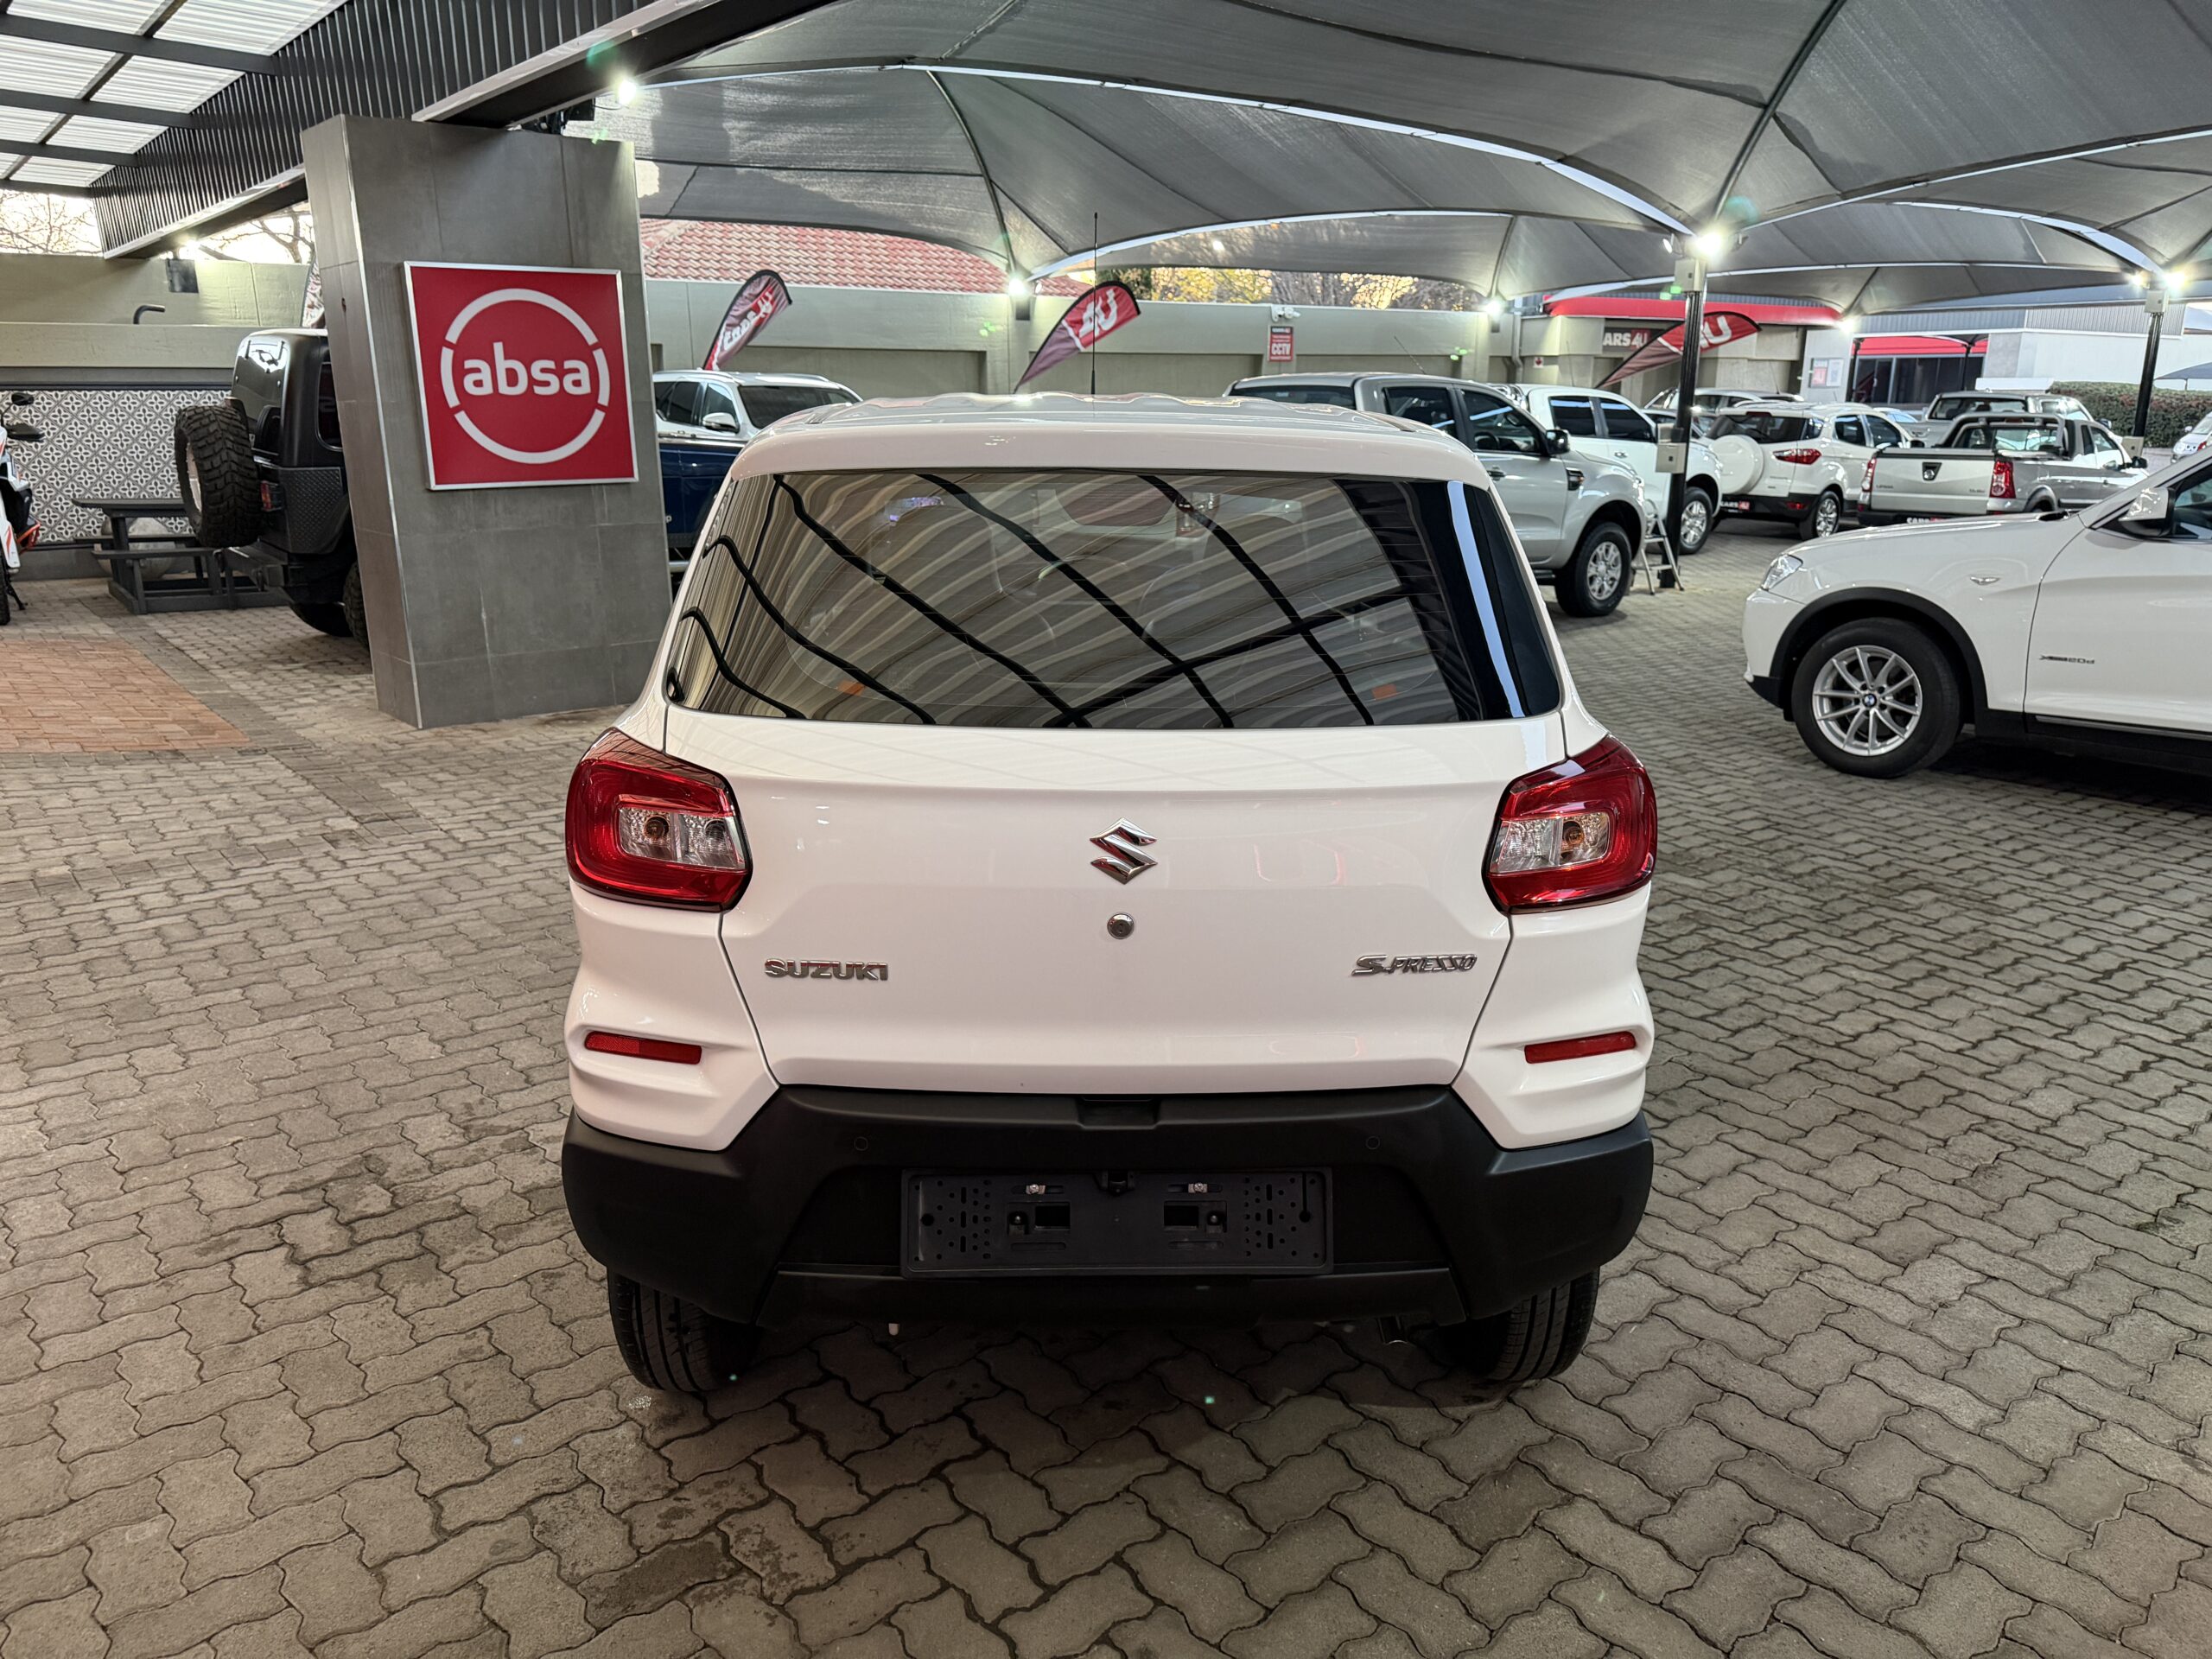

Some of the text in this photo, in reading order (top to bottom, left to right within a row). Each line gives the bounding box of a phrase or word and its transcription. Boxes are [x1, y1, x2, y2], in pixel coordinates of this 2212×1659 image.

[1699, 315, 1732, 348] U
[463, 341, 591, 396] absa
[765, 958, 888, 981] SUZUKI
